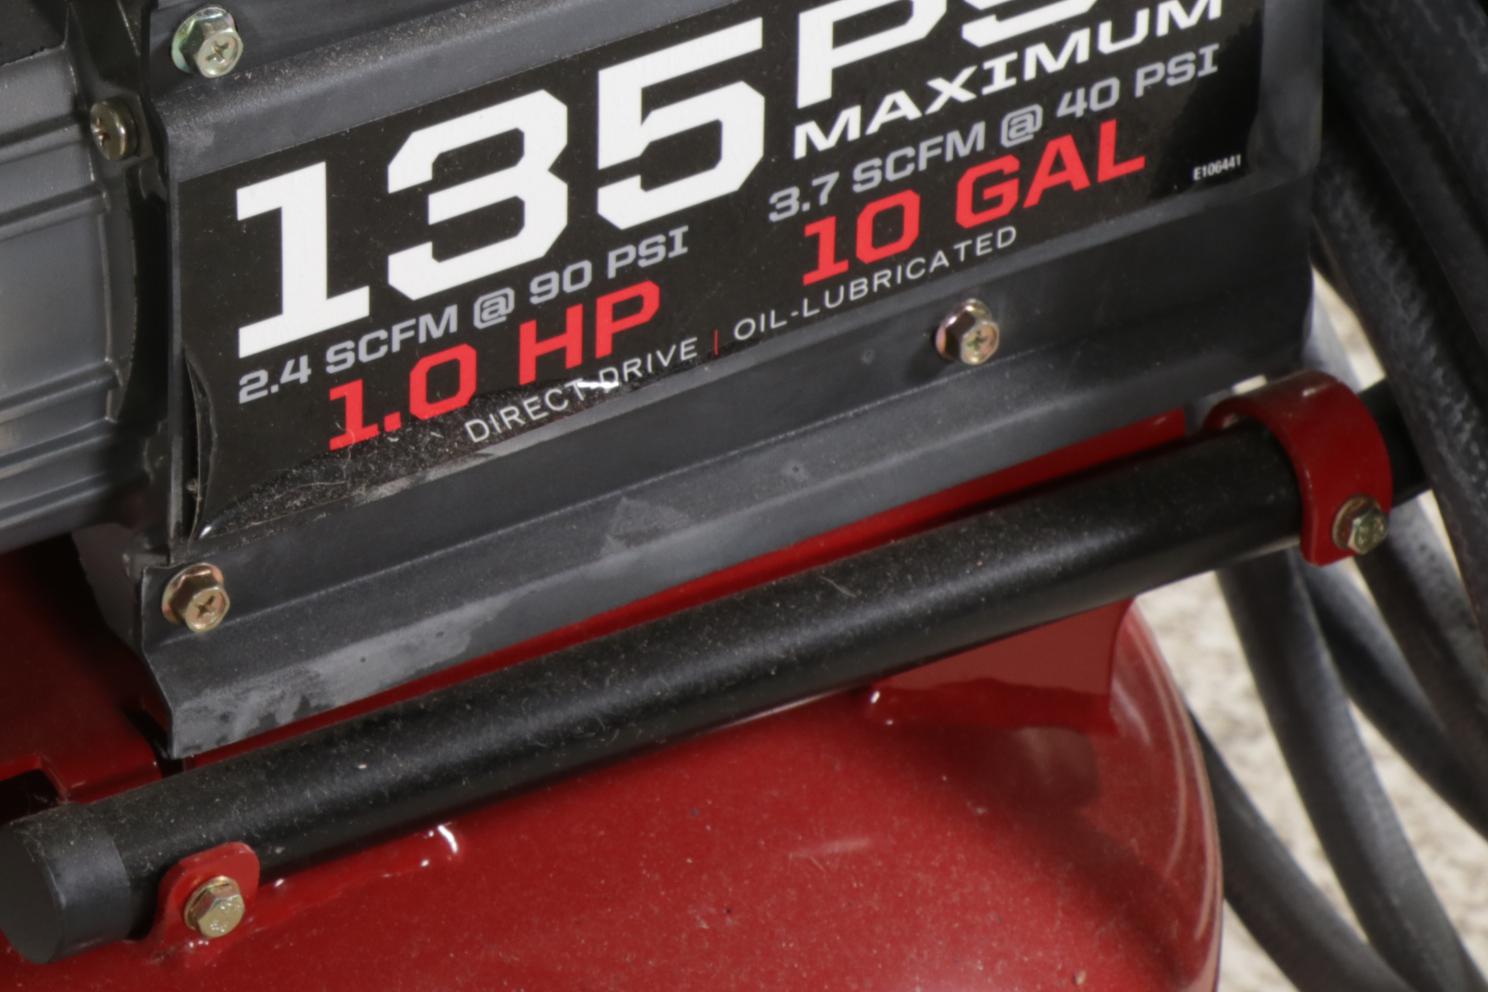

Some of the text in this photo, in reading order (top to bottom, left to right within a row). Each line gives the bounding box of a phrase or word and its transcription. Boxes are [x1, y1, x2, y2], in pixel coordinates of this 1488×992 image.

[235, 16, 766, 359] 135
[768, 43, 1220, 223] 3.7 SCFM @ 40 PSI
[801, 118, 1146, 287] 10 GAL
[238, 225, 689, 404] 2.4 SCFM @ 90 PSI
[328, 279, 661, 451] 1.0 HP
[733, 225, 1017, 342] OIL-LUBRICATED
